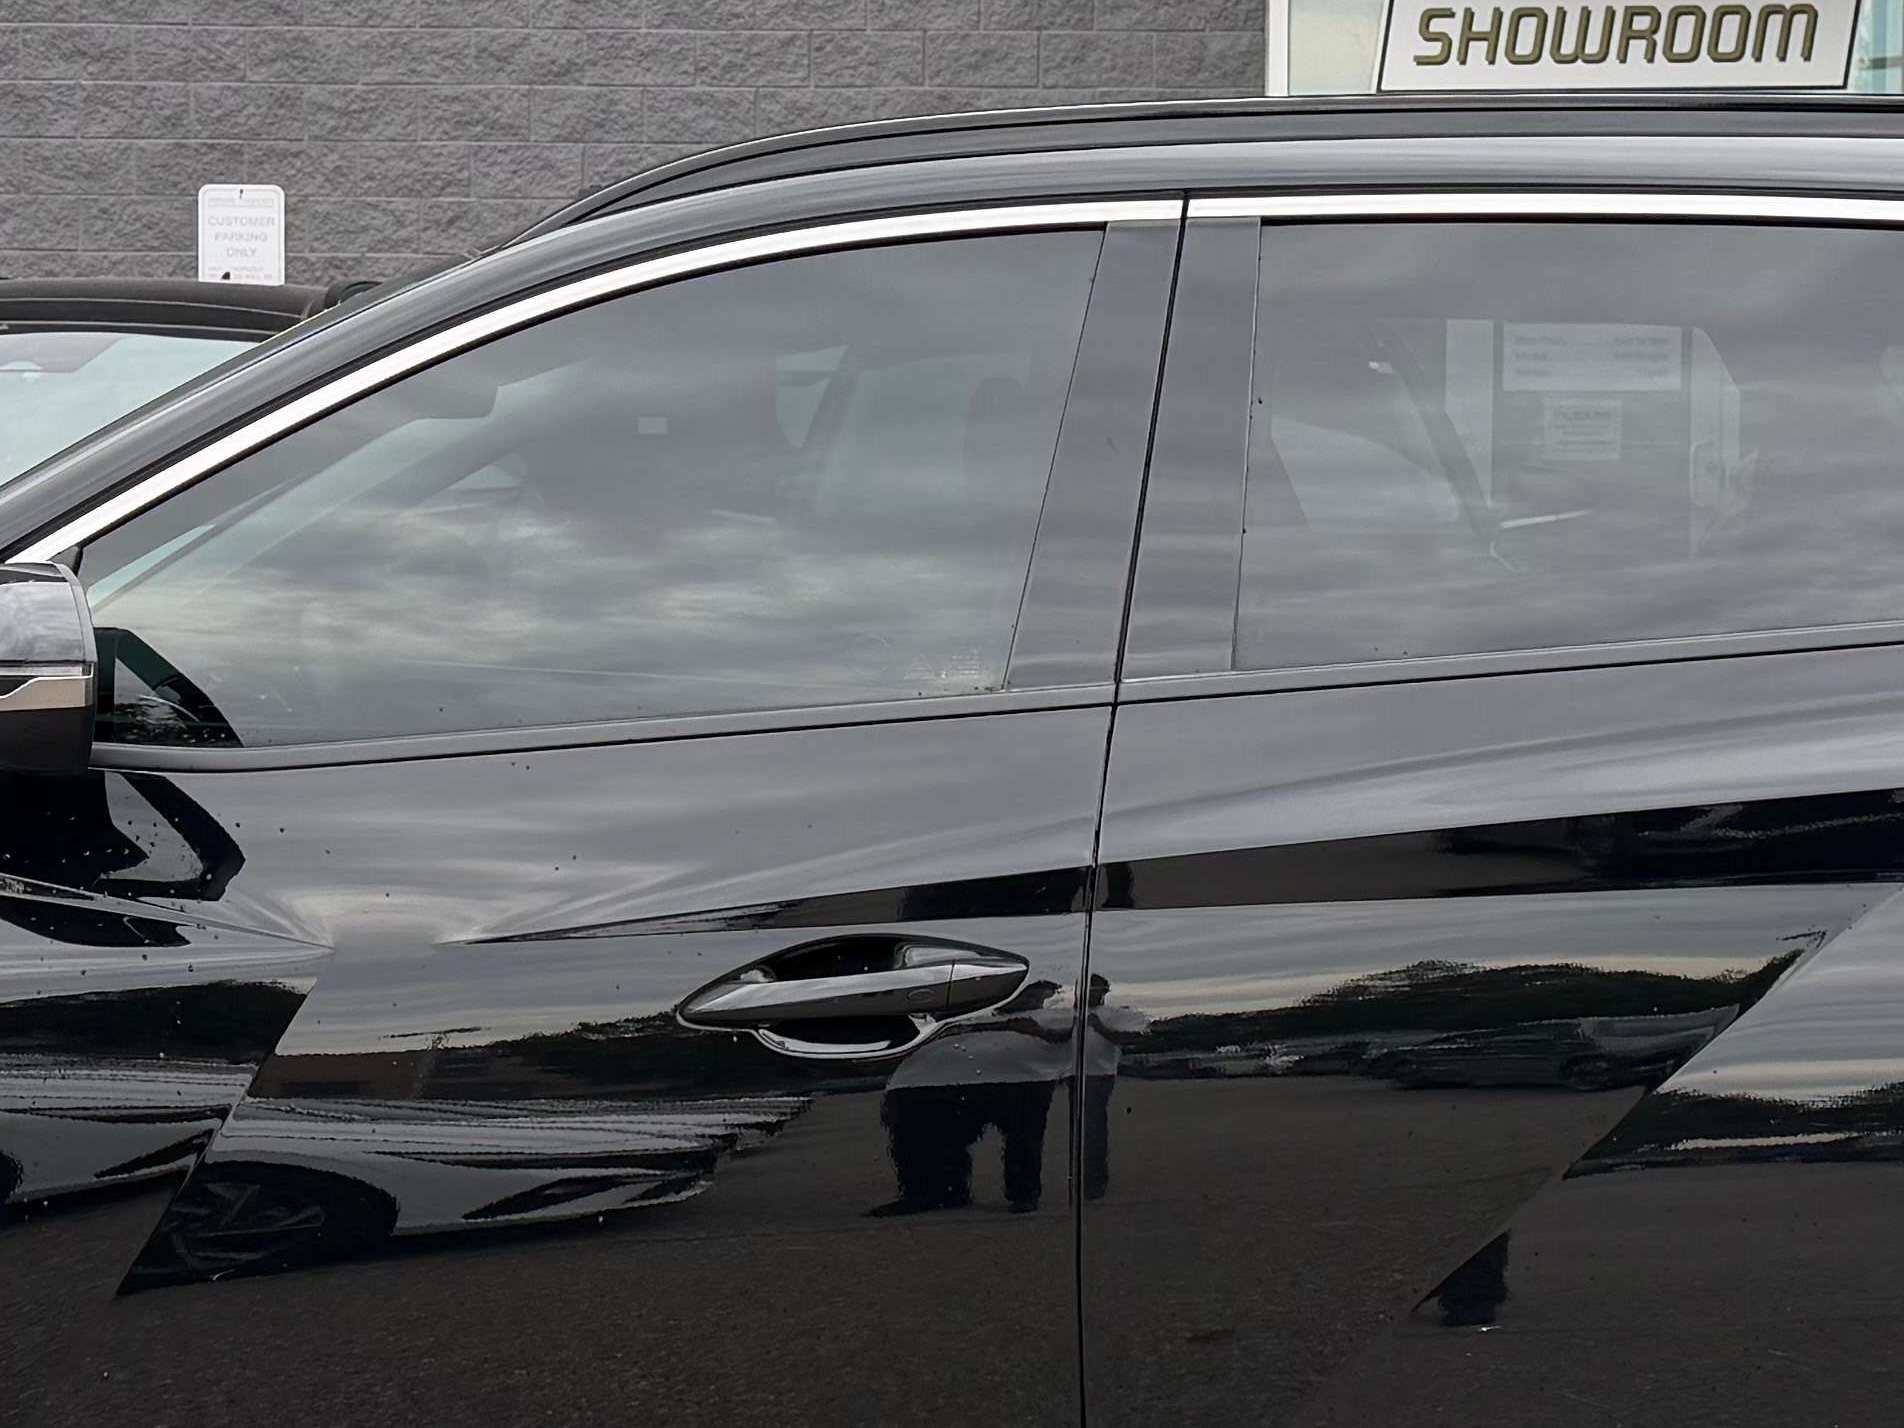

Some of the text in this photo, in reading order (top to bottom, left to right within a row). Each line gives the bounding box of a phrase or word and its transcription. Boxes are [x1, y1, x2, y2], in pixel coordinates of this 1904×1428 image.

[1413, 3, 1819, 67] SHOWROOM
[207, 215, 276, 227] CUSTOMER
[214, 231, 268, 242] PARKING
[226, 247, 257, 258] ONLY
